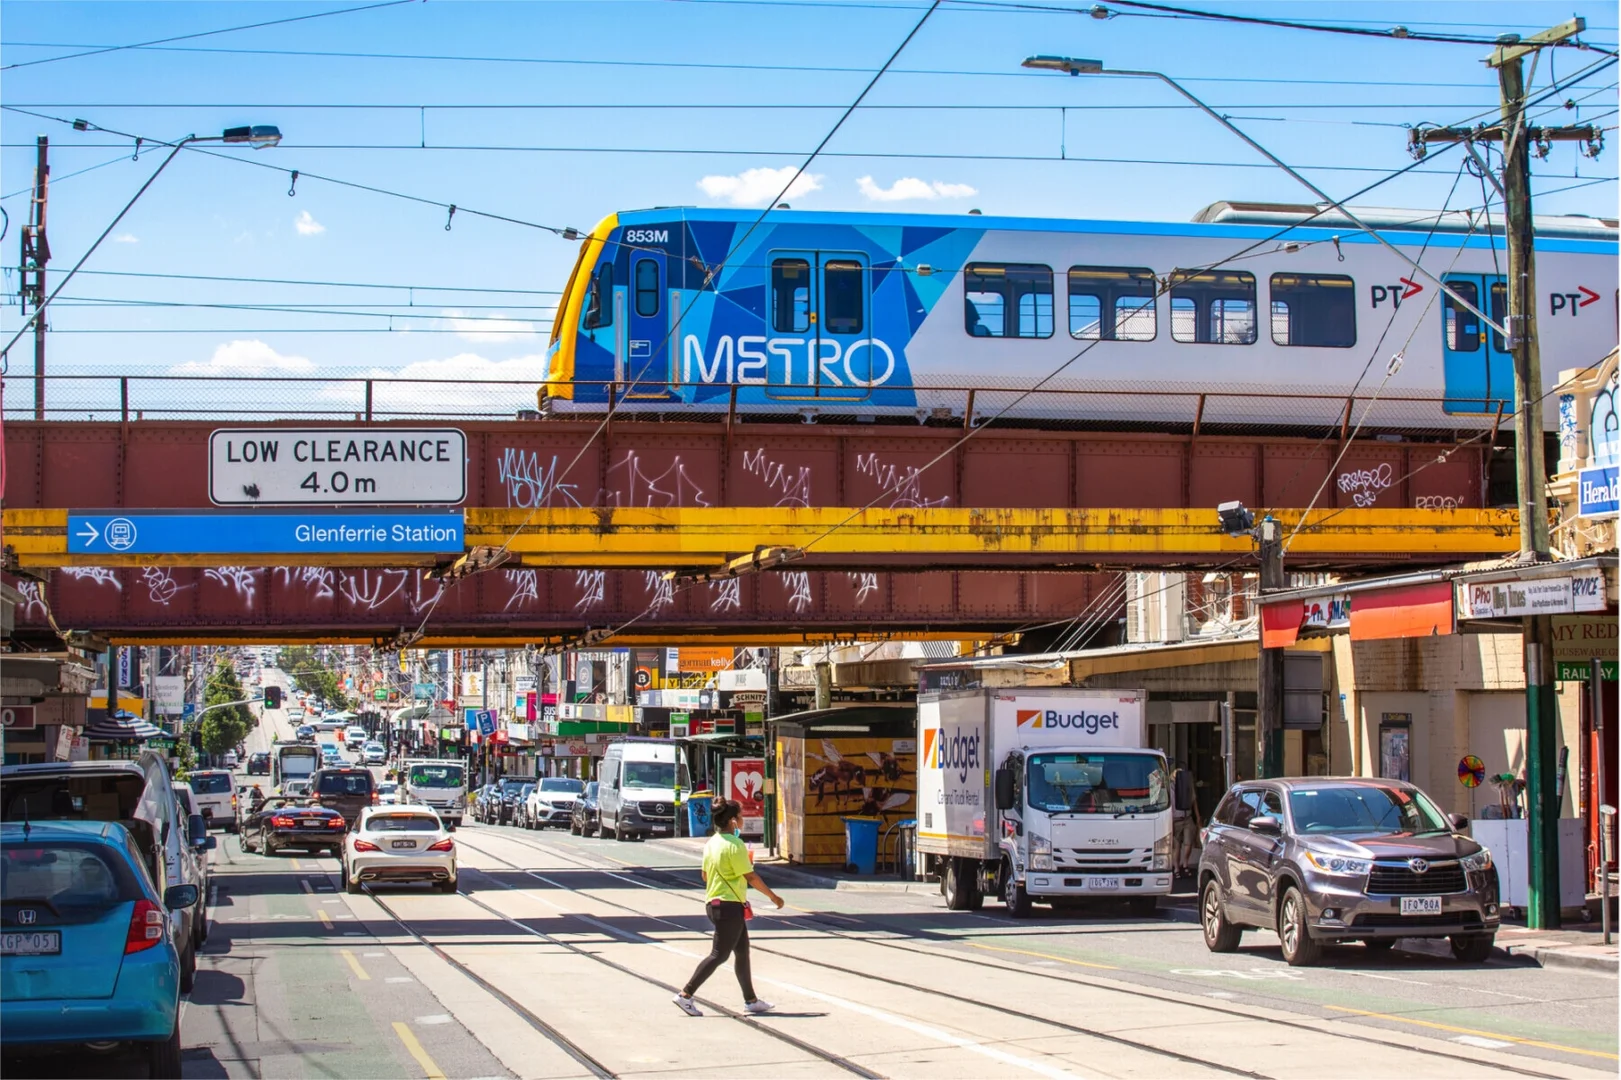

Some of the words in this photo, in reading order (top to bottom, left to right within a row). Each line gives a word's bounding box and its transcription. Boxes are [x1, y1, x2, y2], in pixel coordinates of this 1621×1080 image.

[626, 230, 669, 243] 853M
[683, 334, 895, 387] METRO
[226, 439, 279, 463] LOW
[293, 439, 452, 463] CLEARANCE
[295, 524, 388, 542] Glenferrie
[391, 524, 457, 542] Station
[1474, 587, 1491, 604] Pho
[1562, 667, 1614, 679] RAILAY
[480, 713, 489, 723] P
[1045, 710, 1119, 735] Budget
[938, 727, 980, 784] Budget
[33, 934, 57, 948] 051
